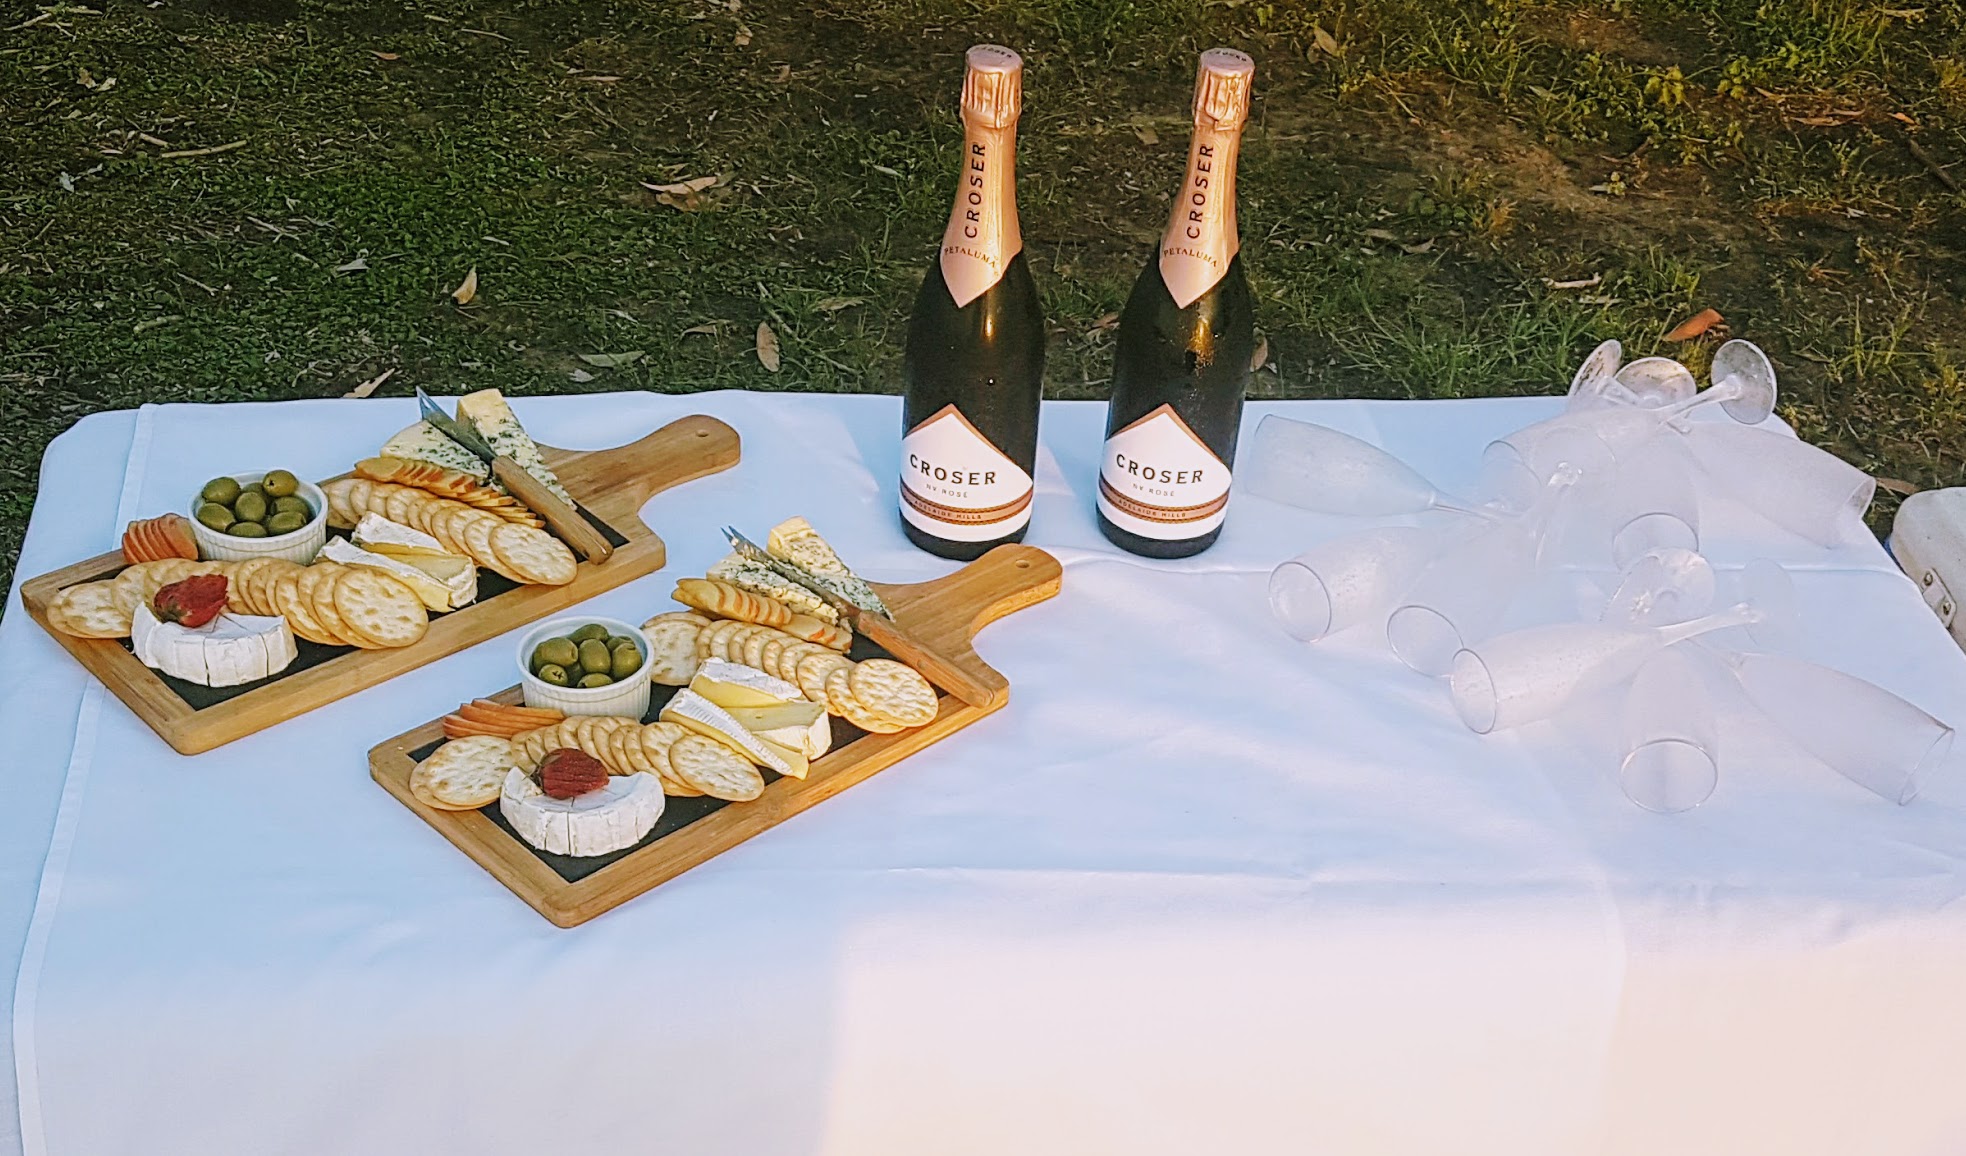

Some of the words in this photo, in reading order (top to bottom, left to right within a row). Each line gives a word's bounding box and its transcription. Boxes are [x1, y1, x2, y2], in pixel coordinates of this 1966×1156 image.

[965, 143, 987, 239] CROSER
[1186, 144, 1214, 239] CROSER
[944, 246, 996, 268] PETALUMA
[1163, 247, 1217, 268] PETALUMA
[909, 453, 997, 486] CROSER
[1115, 453, 1204, 485] CROSER
[914, 500, 951, 517] ADELAIDE
[1118, 499, 1157, 517] ADELAIDE
